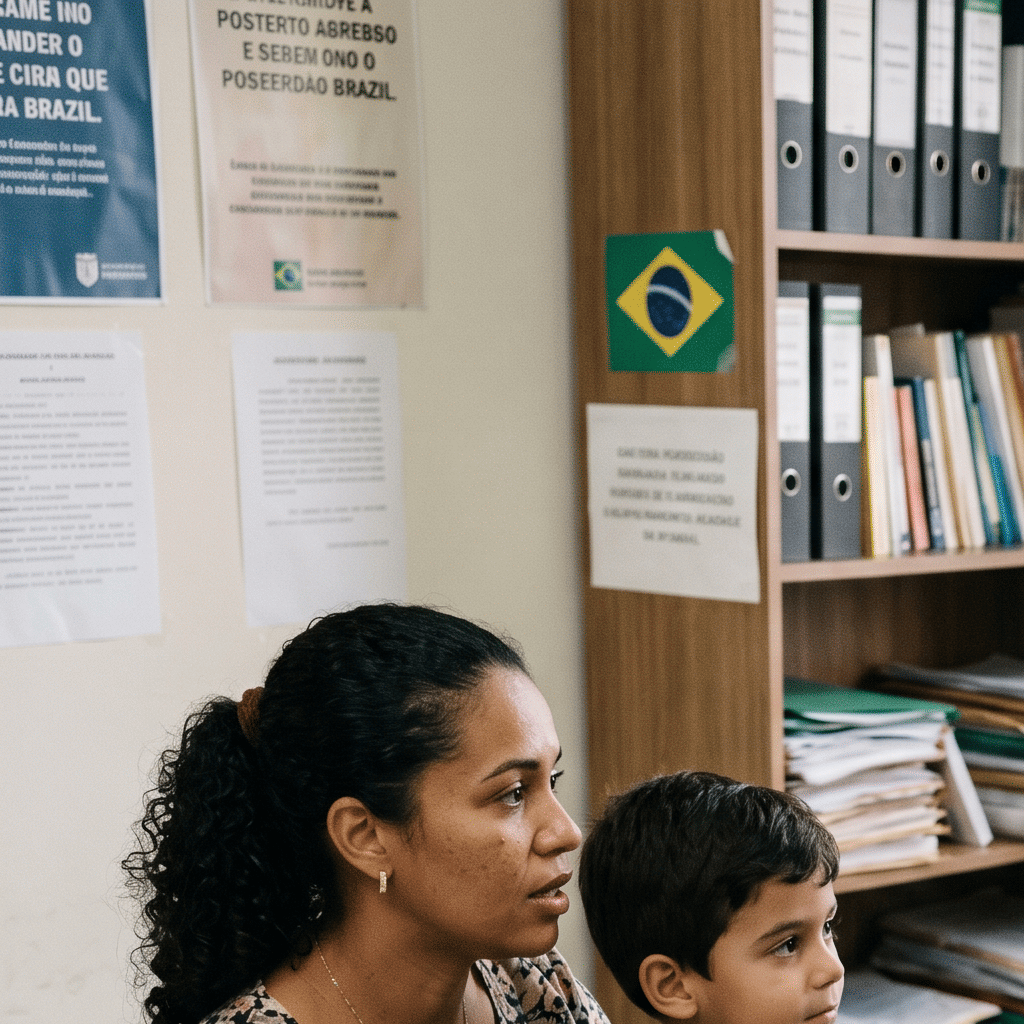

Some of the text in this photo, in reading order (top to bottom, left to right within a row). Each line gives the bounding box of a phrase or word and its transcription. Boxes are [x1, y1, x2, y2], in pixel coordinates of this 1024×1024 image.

[218, 9, 310, 35] POSTERTO
[67, 34, 83, 57] O
[243, 42, 376, 71] E SEBEM ONO O
[65, 67, 109, 93] QUE
[334, 79, 397, 101] BRAZIL.
[23, 96, 102, 122] BRAZIL.
